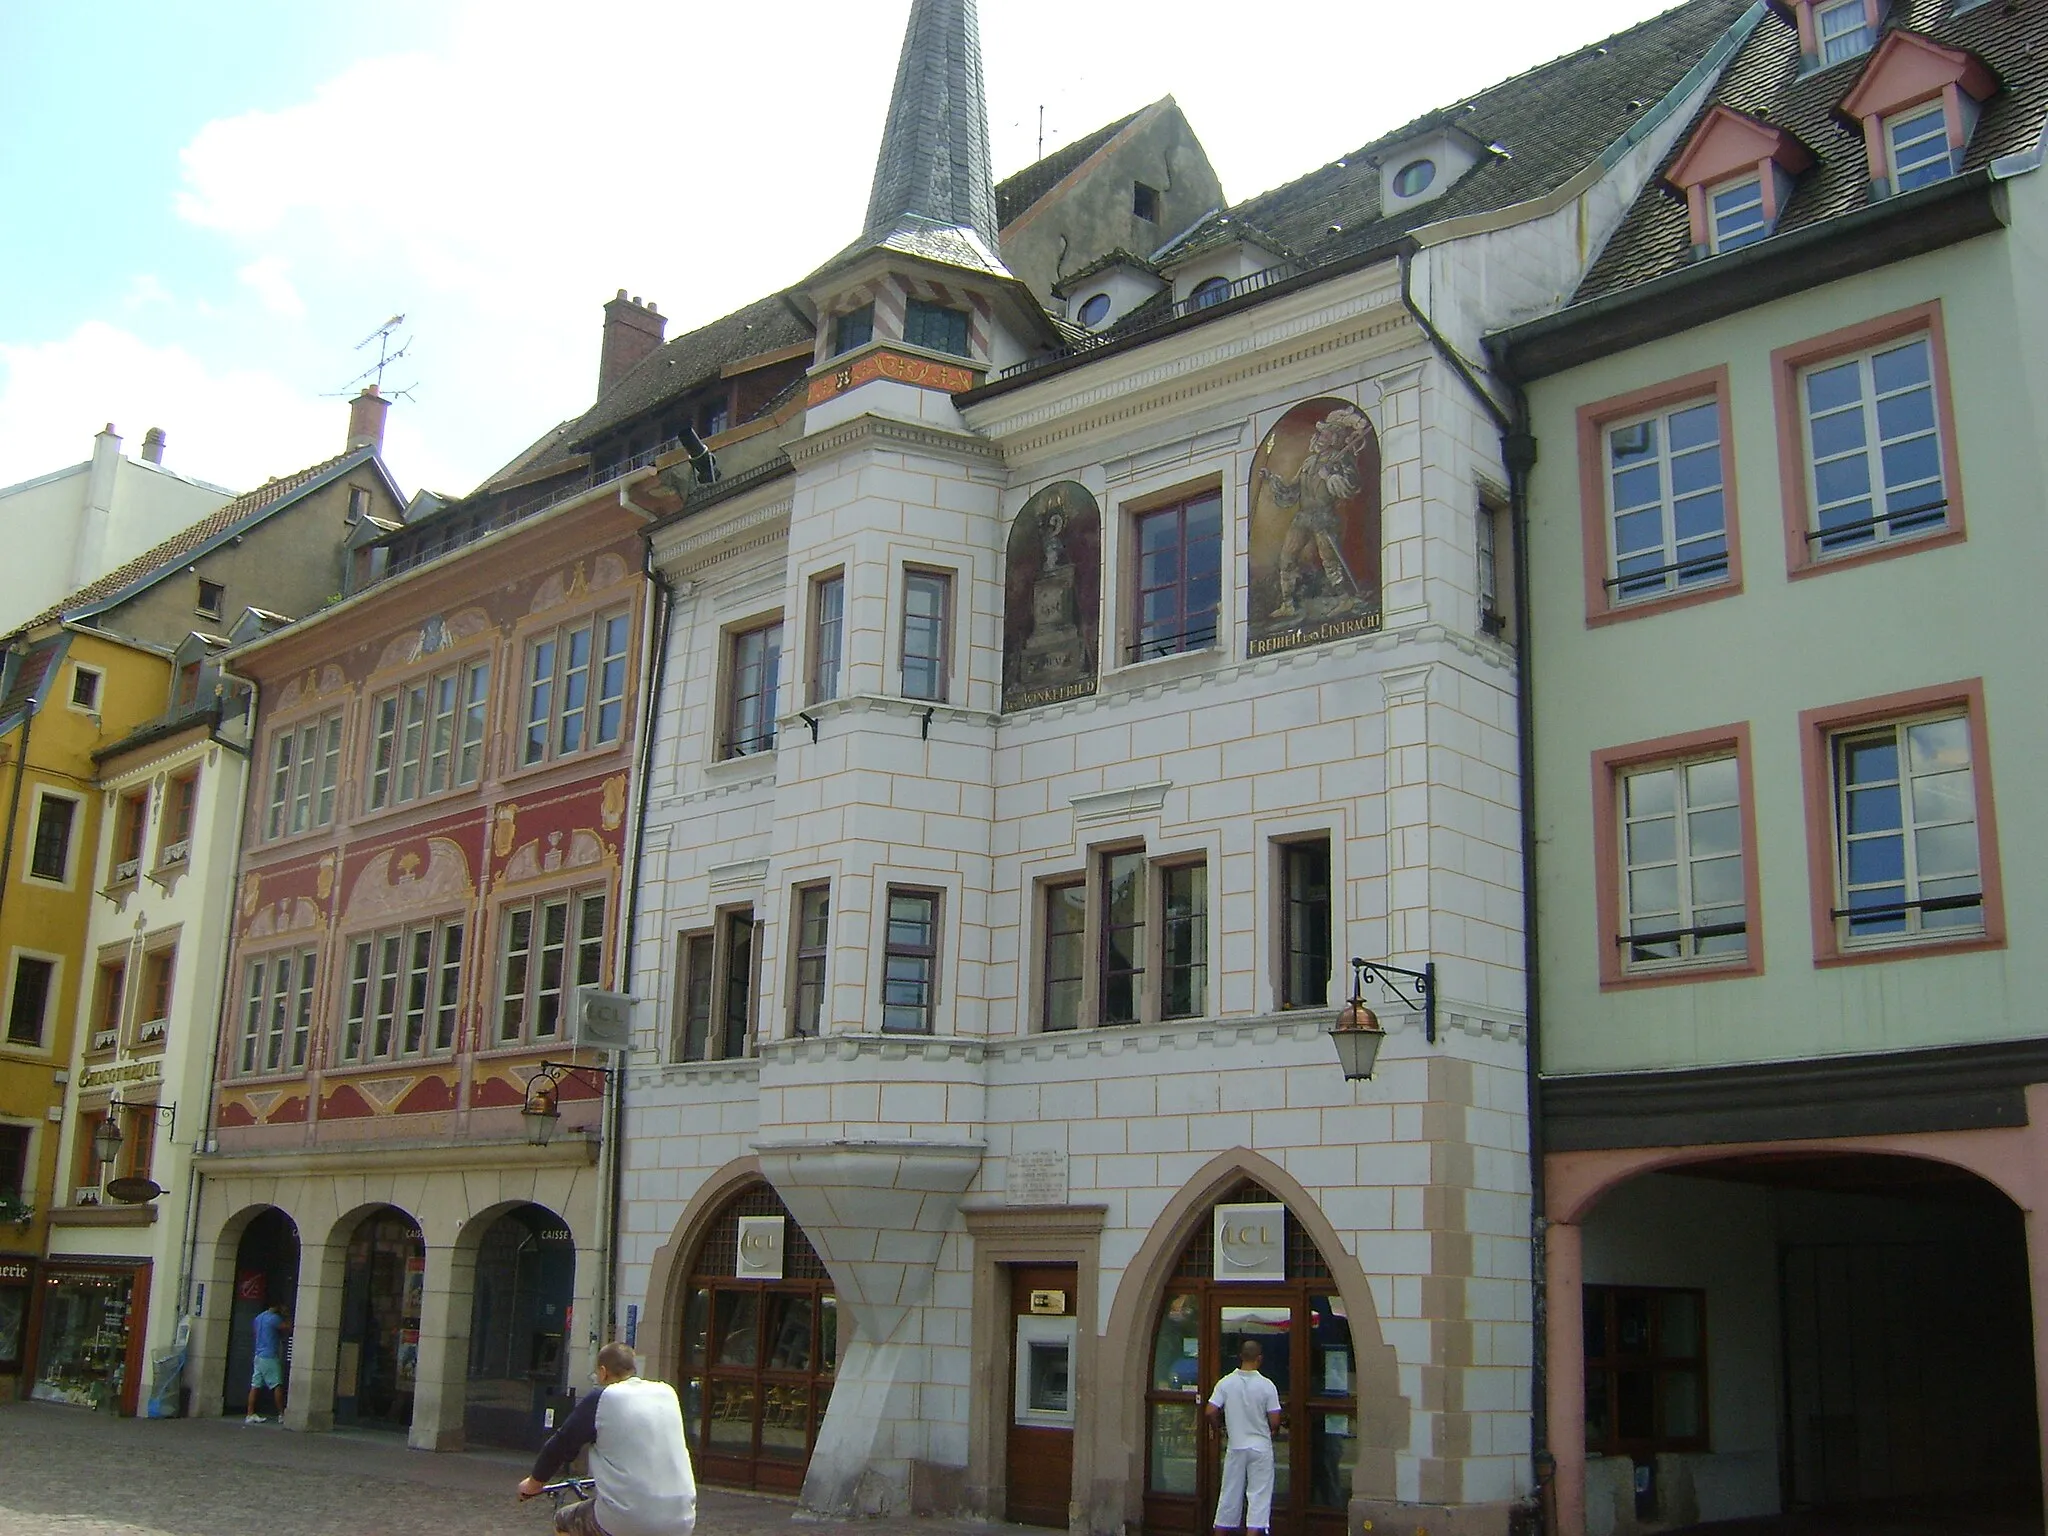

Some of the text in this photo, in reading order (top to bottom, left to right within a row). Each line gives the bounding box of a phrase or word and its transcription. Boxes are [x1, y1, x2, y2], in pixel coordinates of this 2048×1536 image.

[1249, 628, 1301, 654] FREIHEIT
[1320, 613, 1381, 640] EINTRACHT
[541, 1230, 569, 1240] CAISSE
[1226, 1226, 1276, 1246] LCL
